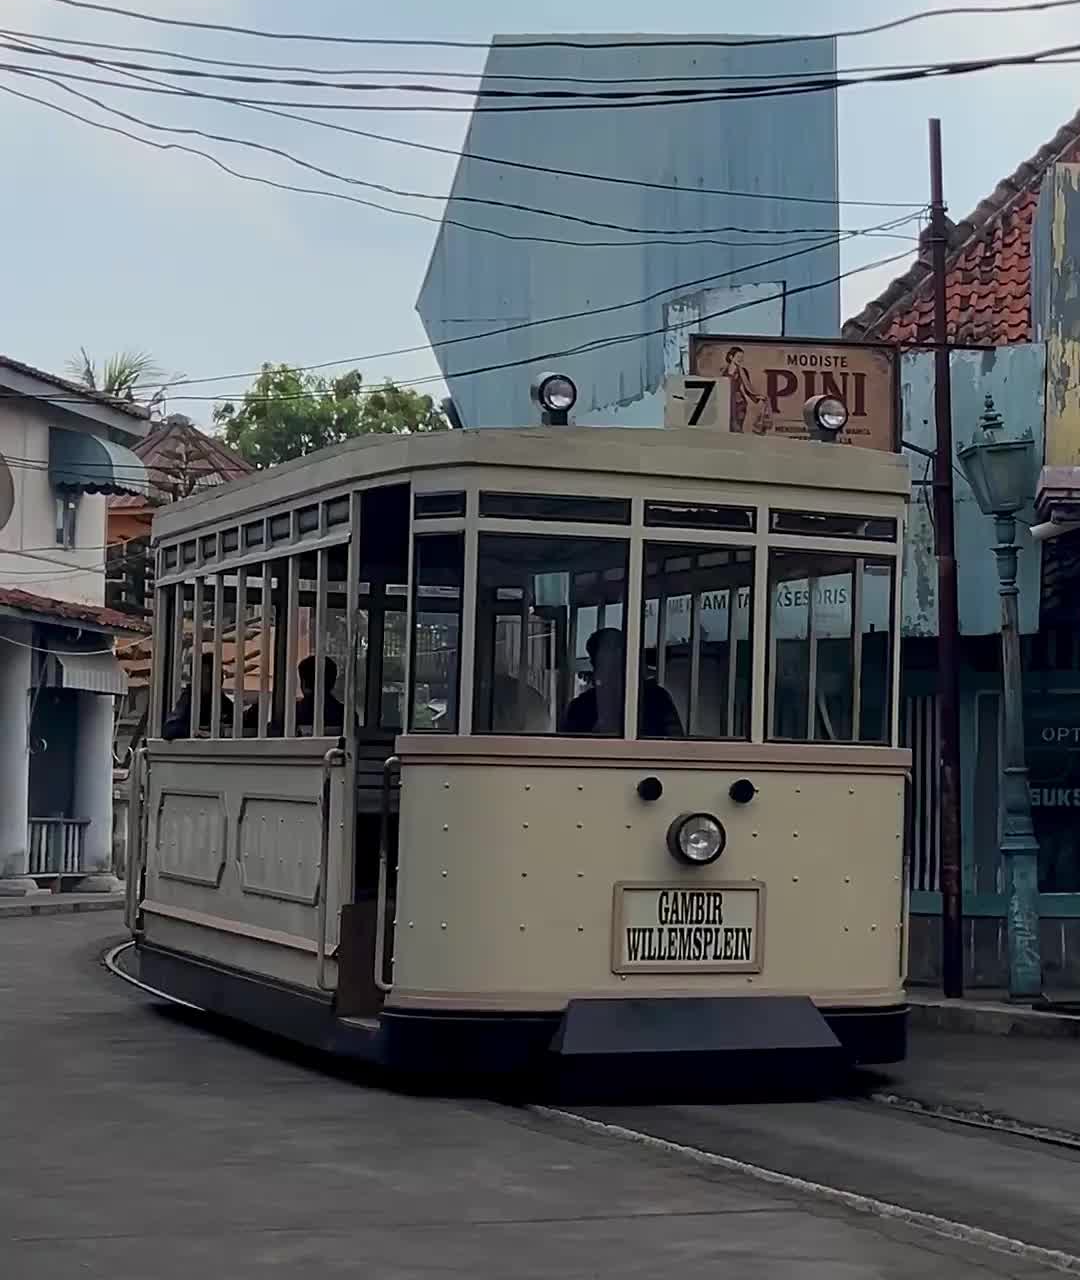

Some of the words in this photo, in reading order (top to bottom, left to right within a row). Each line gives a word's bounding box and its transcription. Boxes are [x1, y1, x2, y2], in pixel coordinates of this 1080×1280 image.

[787, 354, 848, 368] MODISTE
[684, 380, 716, 426] 7
[764, 369, 867, 417] PINI
[658, 890, 723, 925] GAMBIR
[626, 927, 752, 961] WILLEMSPLEIN
